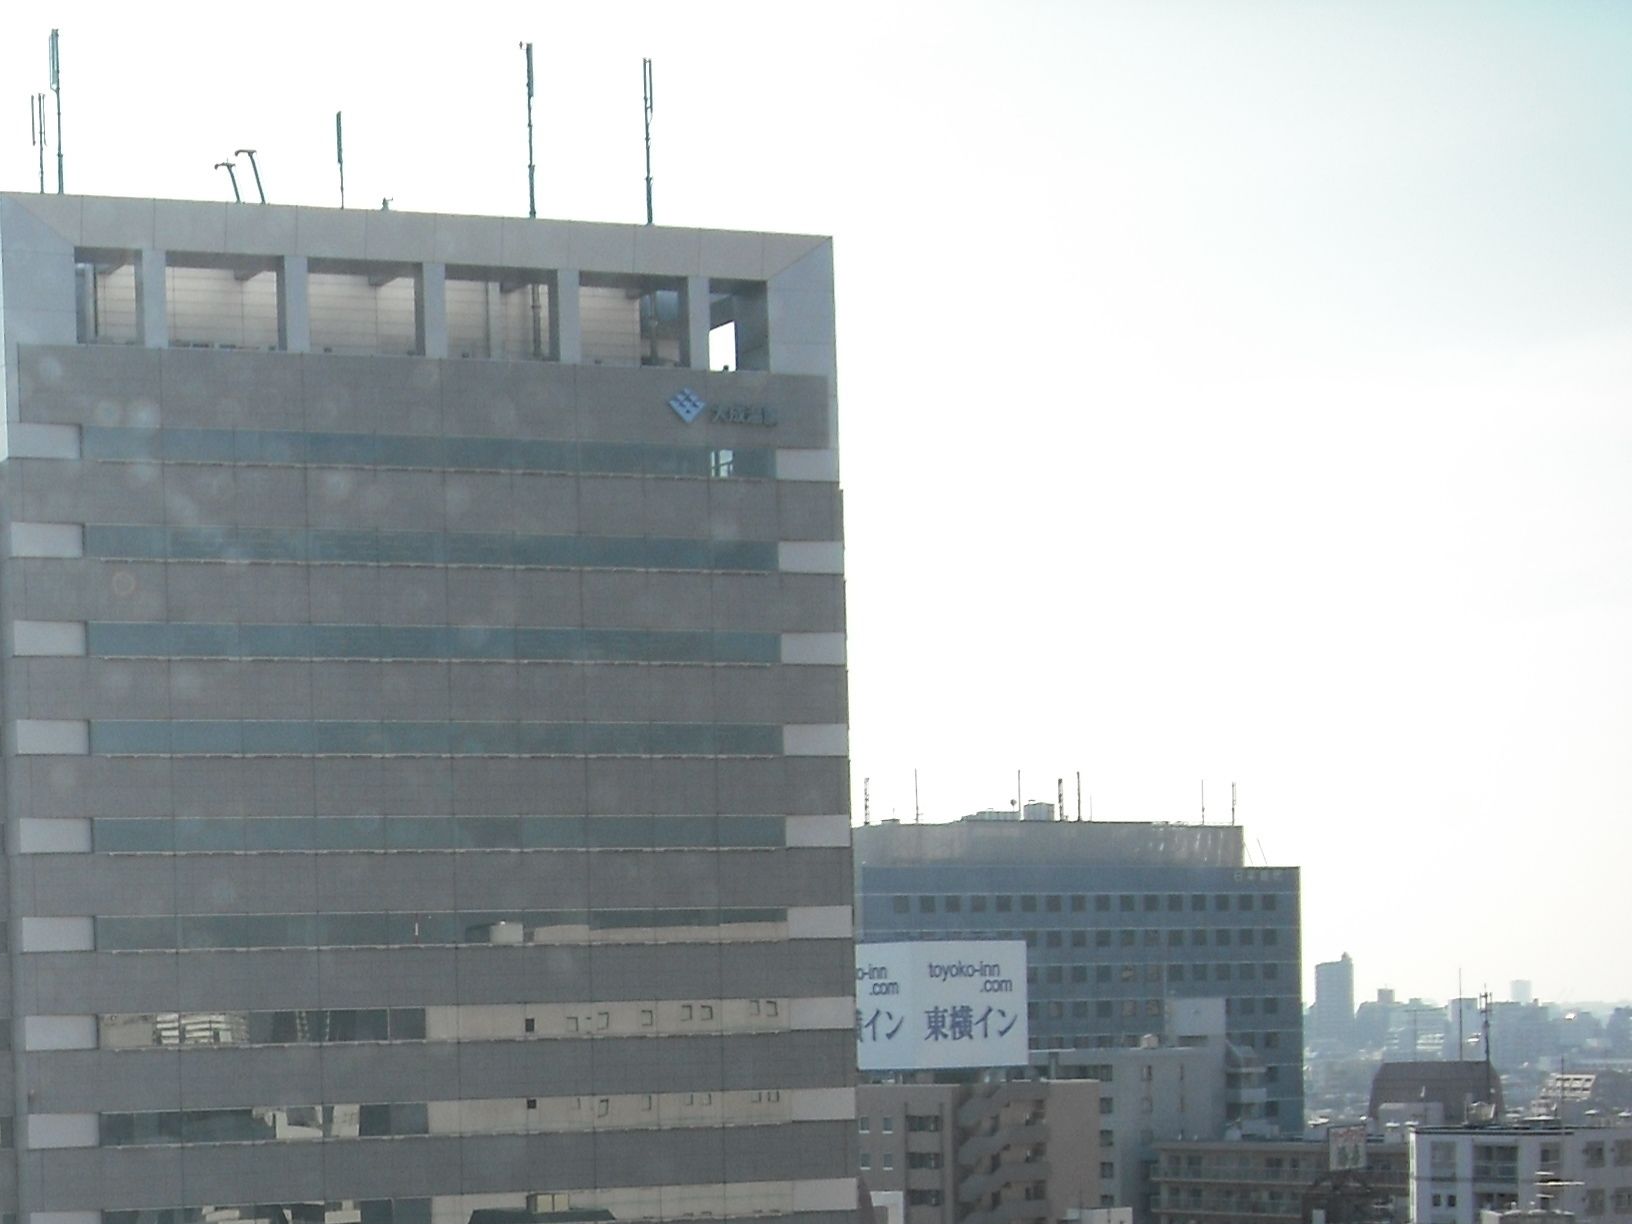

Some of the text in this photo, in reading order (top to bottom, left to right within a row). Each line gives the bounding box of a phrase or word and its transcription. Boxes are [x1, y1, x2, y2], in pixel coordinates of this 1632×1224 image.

[928, 960, 1001, 982] toyoko-inn
[869, 980, 899, 996] .com
[980, 978, 1013, 993] .com
[924, 1005, 1019, 1041] 東横イン
